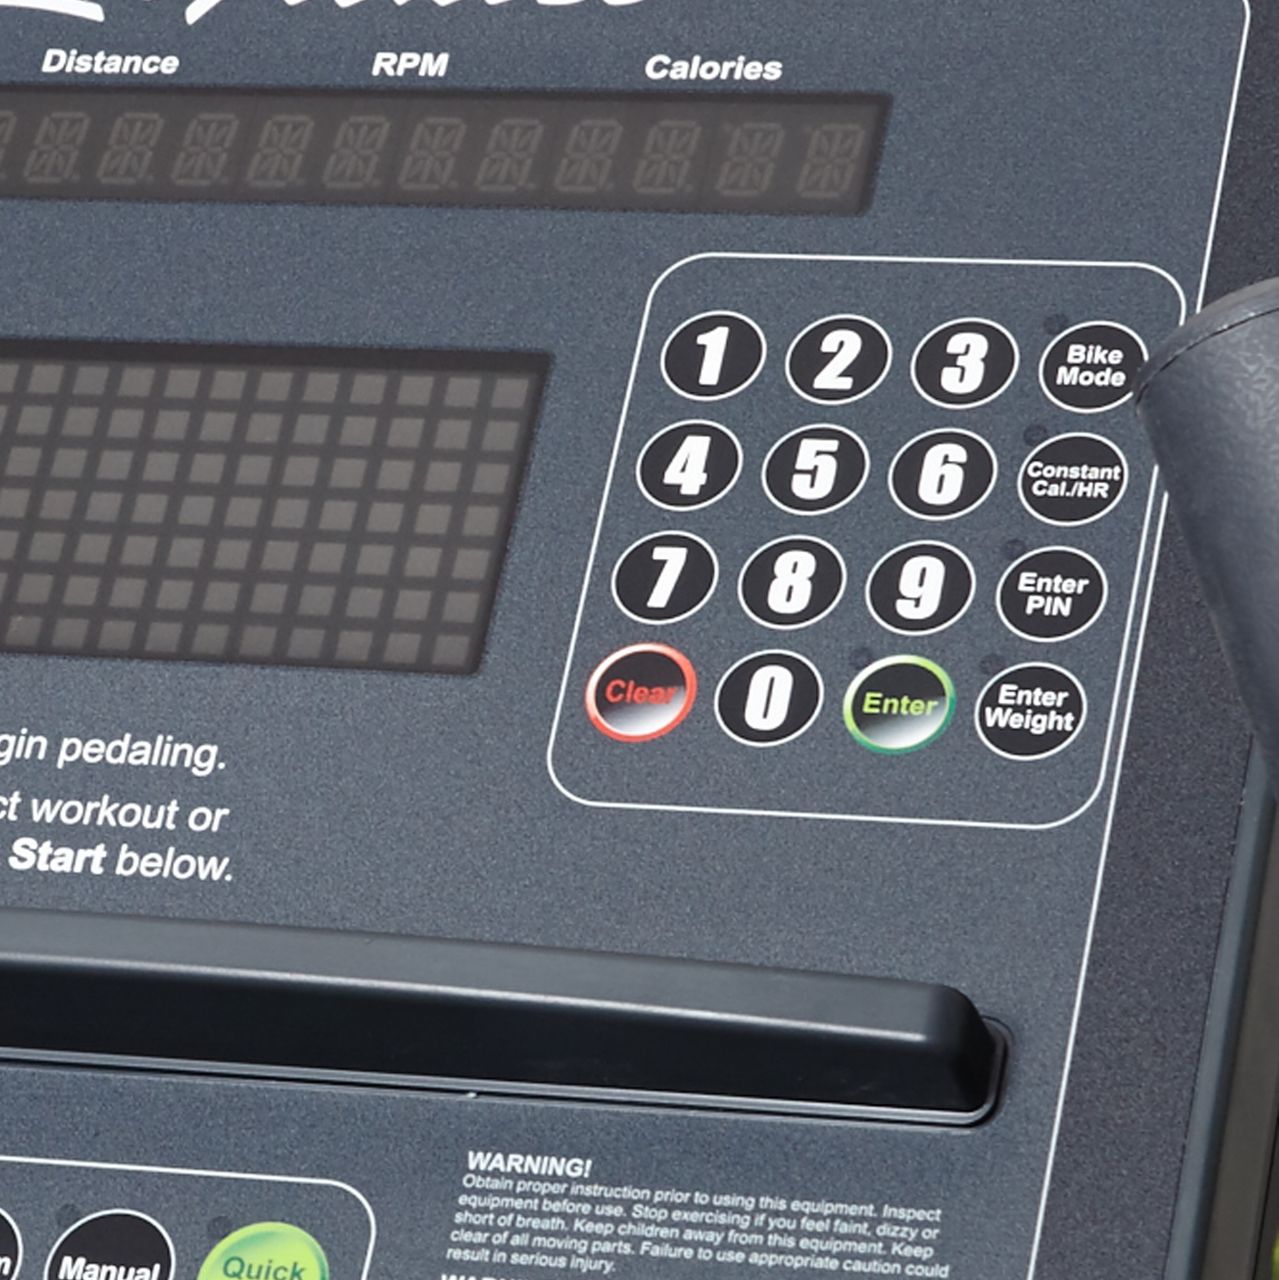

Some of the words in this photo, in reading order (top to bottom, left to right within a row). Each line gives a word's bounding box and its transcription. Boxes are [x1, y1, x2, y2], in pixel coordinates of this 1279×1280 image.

[41, 48, 180, 77] Distance
[372, 52, 449, 78] RPM
[644, 54, 782, 82] Calories
[696, 326, 729, 386] 1
[812, 329, 862, 391] 2
[940, 332, 987, 394] 3
[1067, 343, 1124, 367] Bike
[1056, 365, 1127, 389] Mode
[664, 435, 711, 496] 4
[792, 438, 839, 501] 5
[919, 442, 967, 505] 6
[1027, 462, 1122, 481] Constant
[1031, 479, 1110, 499] Cal./HR
[647, 546, 687, 608] 7
[767, 550, 815, 614] 8
[896, 556, 944, 620] 9
[1018, 571, 1089, 595] Enter
[1026, 595, 1072, 618] PIN
[604, 680, 677, 704] Clear
[744, 665, 793, 731] 0
[861, 692, 939, 717] Enter
[997, 684, 1069, 709] Enter
[985, 707, 1074, 734] Weight
[57, 733, 226, 776] pedaling.
[31, 795, 179, 830] workout
[187, 806, 229, 832] or
[8, 837, 107, 874] Start
[115, 844, 233, 882] below.
[467, 1149, 592, 1178] WARNING!
[461, 1172, 514, 1190] Obtain
[515, 1179, 568, 1195] proper
[569, 1181, 651, 1200] instruction
[652, 1188, 691, 1203] prior
[693, 1190, 710, 1205] to
[711, 1193, 755, 1211] using
[758, 1195, 787, 1211] this
[789, 1199, 877, 1217] equipment.
[881, 1203, 942, 1222] Inspect
[453, 1209, 495, 1226] short
[496, 1212, 514, 1227] of
[515, 1213, 568, 1230] breath.
[572, 1217, 615, 1236] Keep
[616, 1221, 679, 1238] children
[682, 1228, 725, 1245] away
[727, 1228, 764, 1245] from
[766, 1232, 796, 1248] this
[798, 1236, 886, 1254] equipment.
[890, 1241, 934, 1260] Keep
[445, 1247, 490, 1262] result
[491, 1248, 507, 1263] in
[509, 1251, 567, 1268] serious
[569, 1254, 615, 1274] injury.
